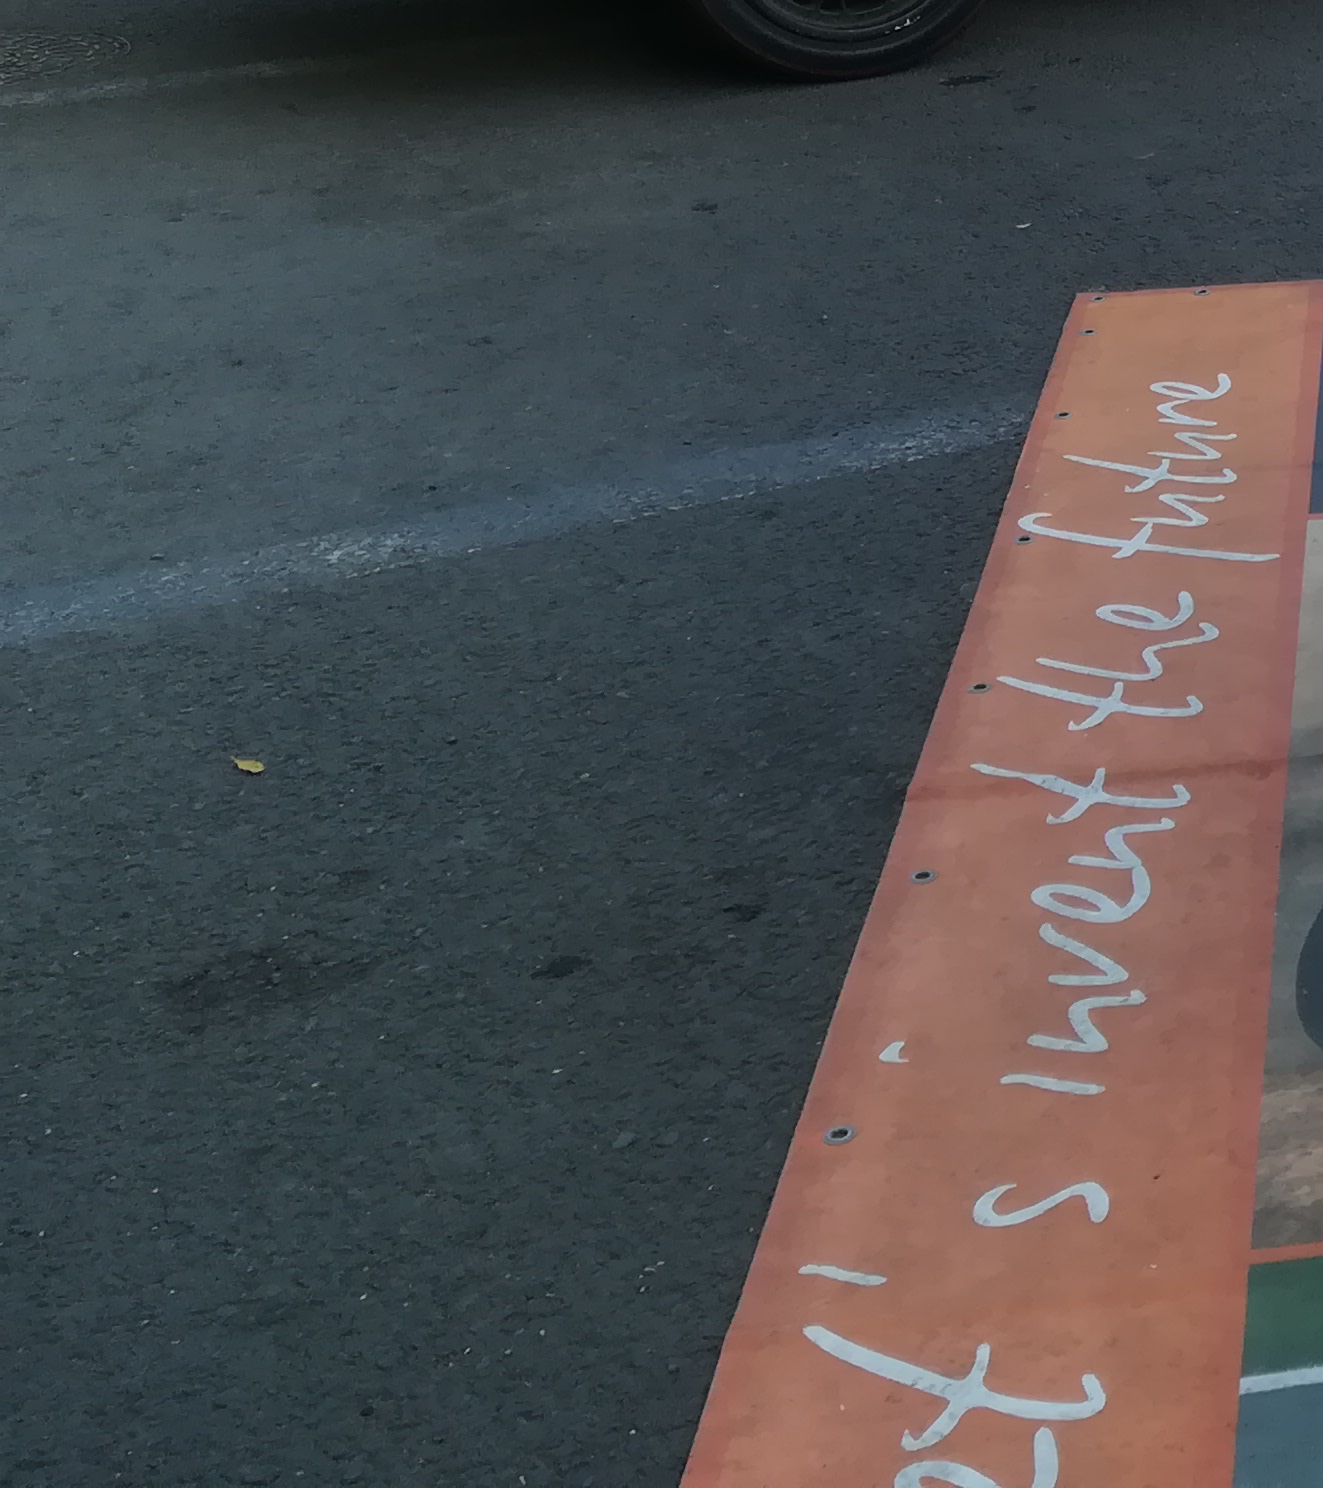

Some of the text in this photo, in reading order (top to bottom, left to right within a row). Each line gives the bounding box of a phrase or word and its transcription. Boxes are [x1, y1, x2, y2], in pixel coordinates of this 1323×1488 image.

[1018, 373, 1280, 562] future
[996, 590, 1220, 731] the
[878, 762, 1192, 1096] invent
